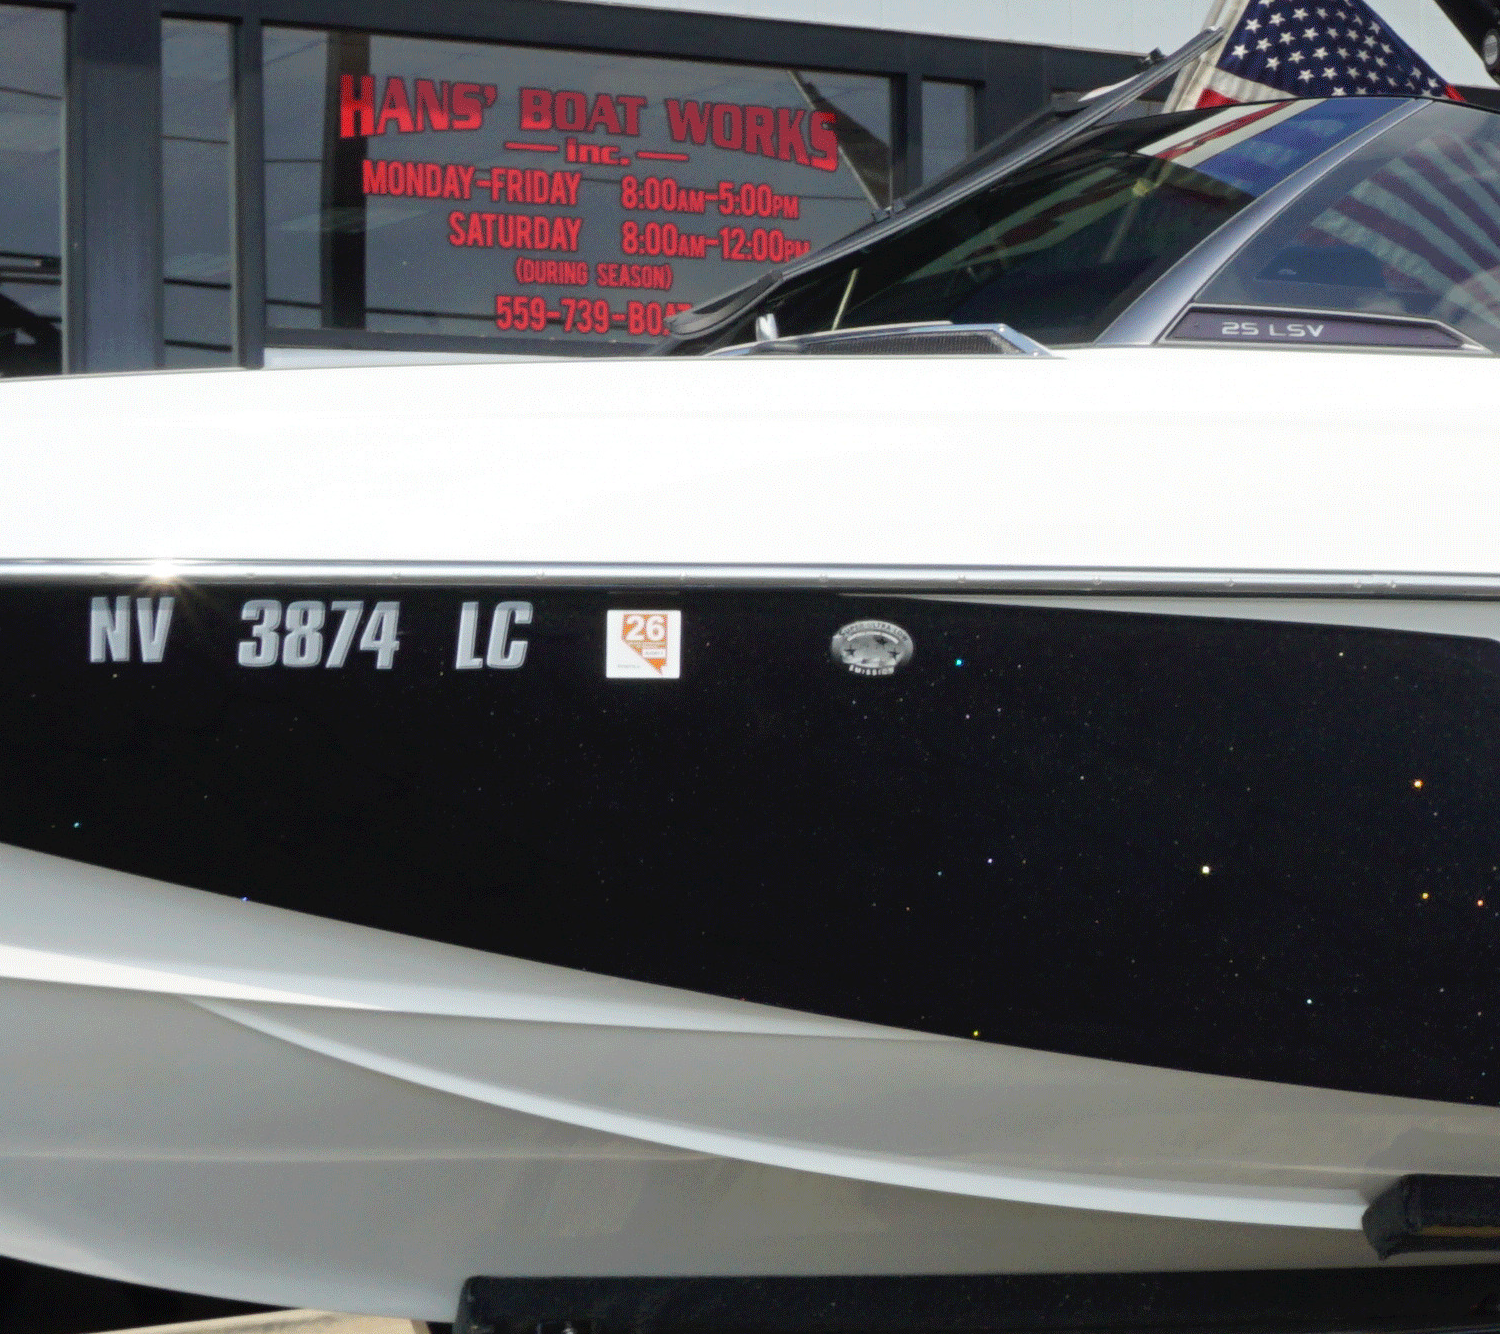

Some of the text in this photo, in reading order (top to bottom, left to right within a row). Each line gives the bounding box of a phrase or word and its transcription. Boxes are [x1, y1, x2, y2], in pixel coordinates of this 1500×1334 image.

[339, 73, 838, 172] HANS' BOAT WORKS
[565, 137, 631, 167] inc.
[362, 159, 799, 219] MONDAY-FRIDAY 8:00AM-5:00PM
[449, 211, 583, 252] SATURDAY
[515, 256, 673, 291] (DURING SEASON)
[1221, 321, 1324, 338] 25 LSV
[89, 595, 534, 670] NV 3874 LC
[625, 614, 666, 642] 26
